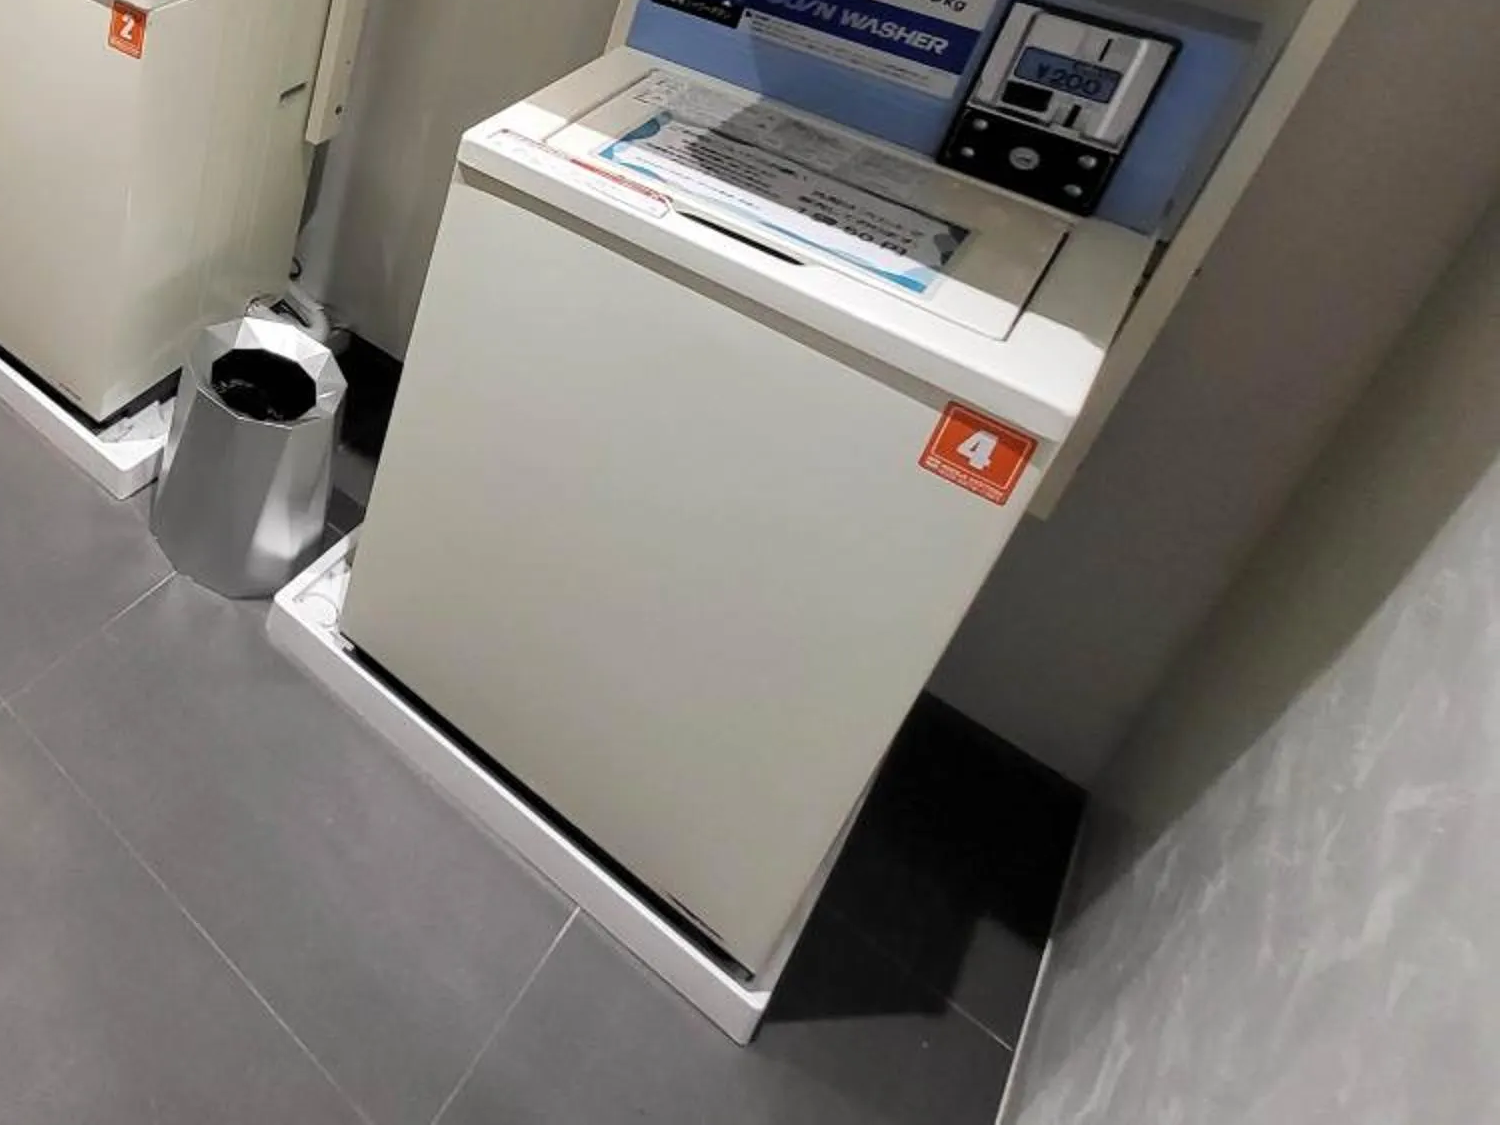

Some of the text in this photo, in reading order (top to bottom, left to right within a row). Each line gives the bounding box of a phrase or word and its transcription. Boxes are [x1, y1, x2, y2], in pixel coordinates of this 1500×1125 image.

[120, 13, 135, 40] 2
[840, 7, 950, 56] WASHER
[956, 428, 1000, 471] 4
